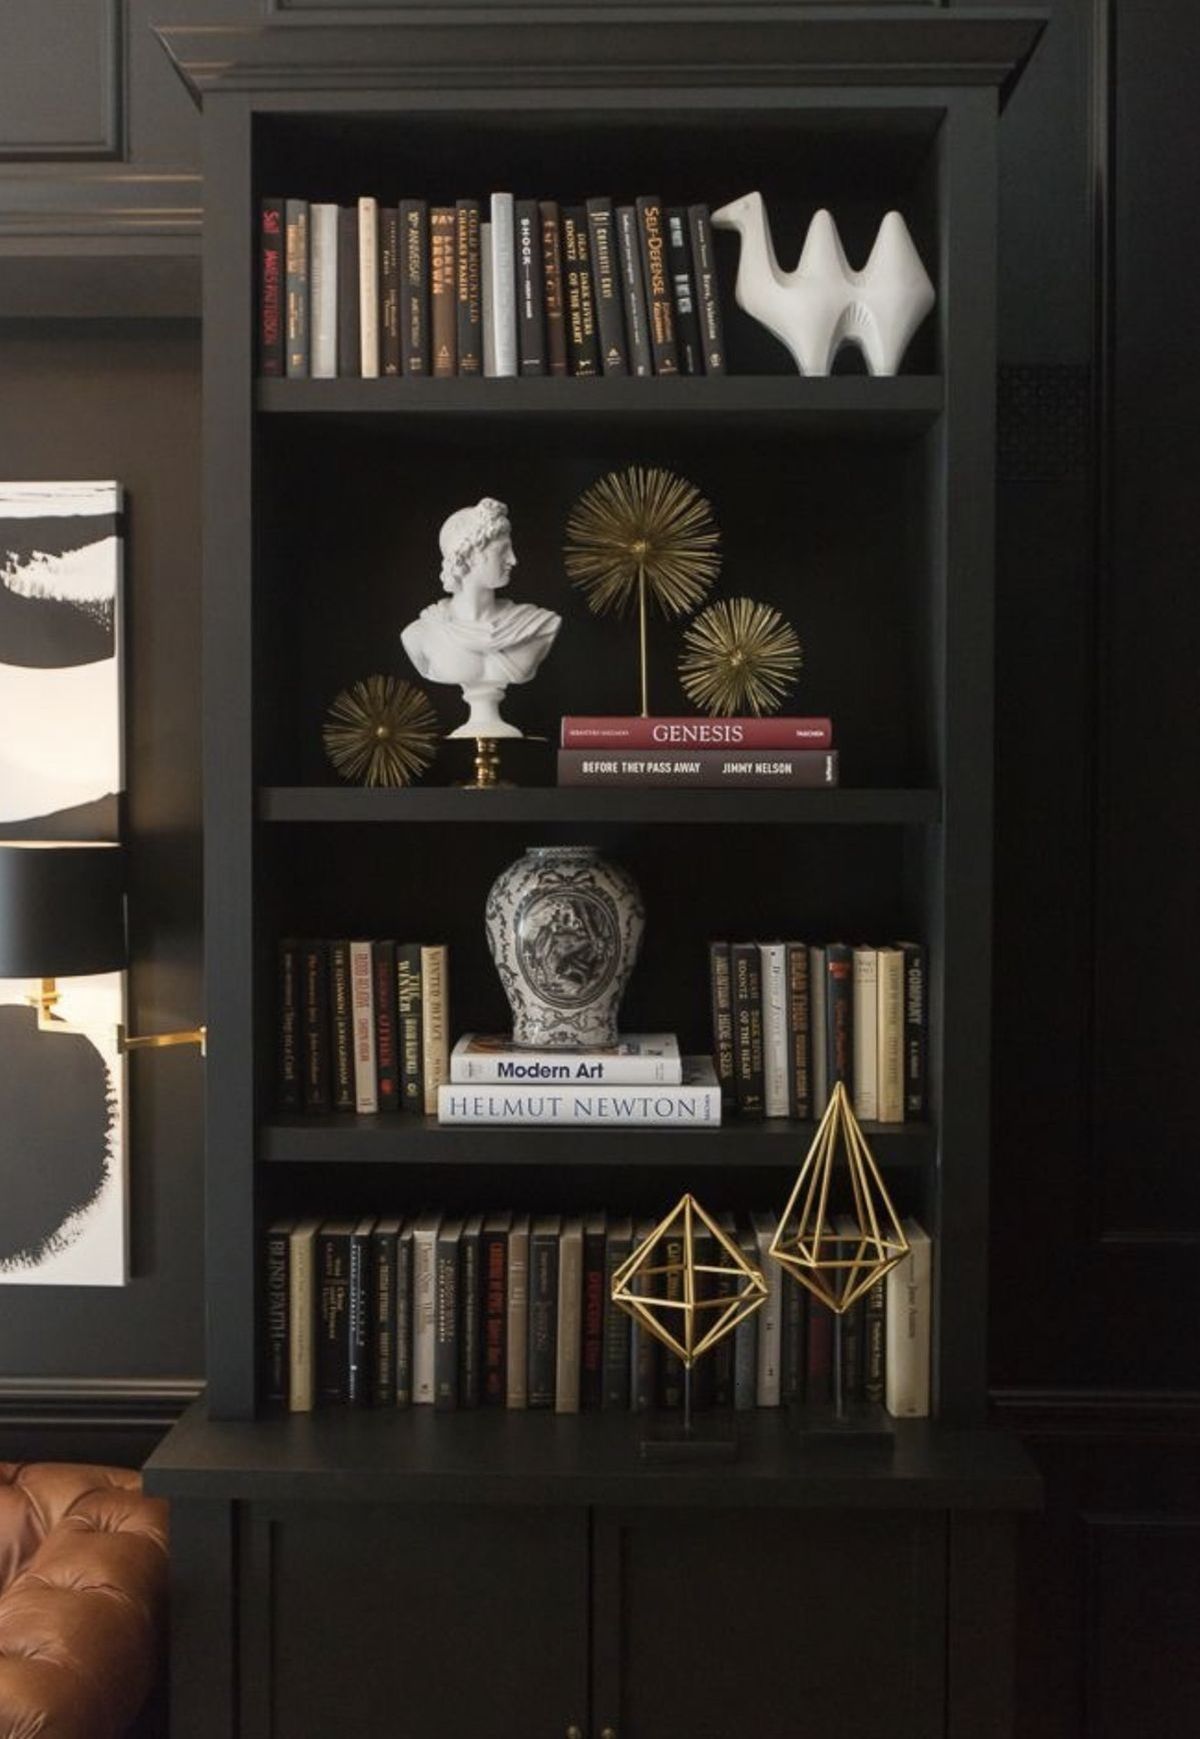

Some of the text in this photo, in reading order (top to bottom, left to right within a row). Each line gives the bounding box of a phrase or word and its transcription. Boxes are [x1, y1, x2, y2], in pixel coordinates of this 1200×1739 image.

[521, 218, 532, 265] SHOCK
[652, 725, 744, 743] GENESIS
[582, 761, 701, 774] BEFORE THEY PASS AWAY
[722, 762, 792, 775] JIMMY NELSON
[398, 960, 412, 1012] WINNER
[908, 968, 923, 1025] COMPANY
[497, 1061, 571, 1079] Modern
[576, 1061, 604, 1078] Art
[449, 1097, 563, 1116] HELMUT
[573, 1097, 697, 1118] NEWTON
